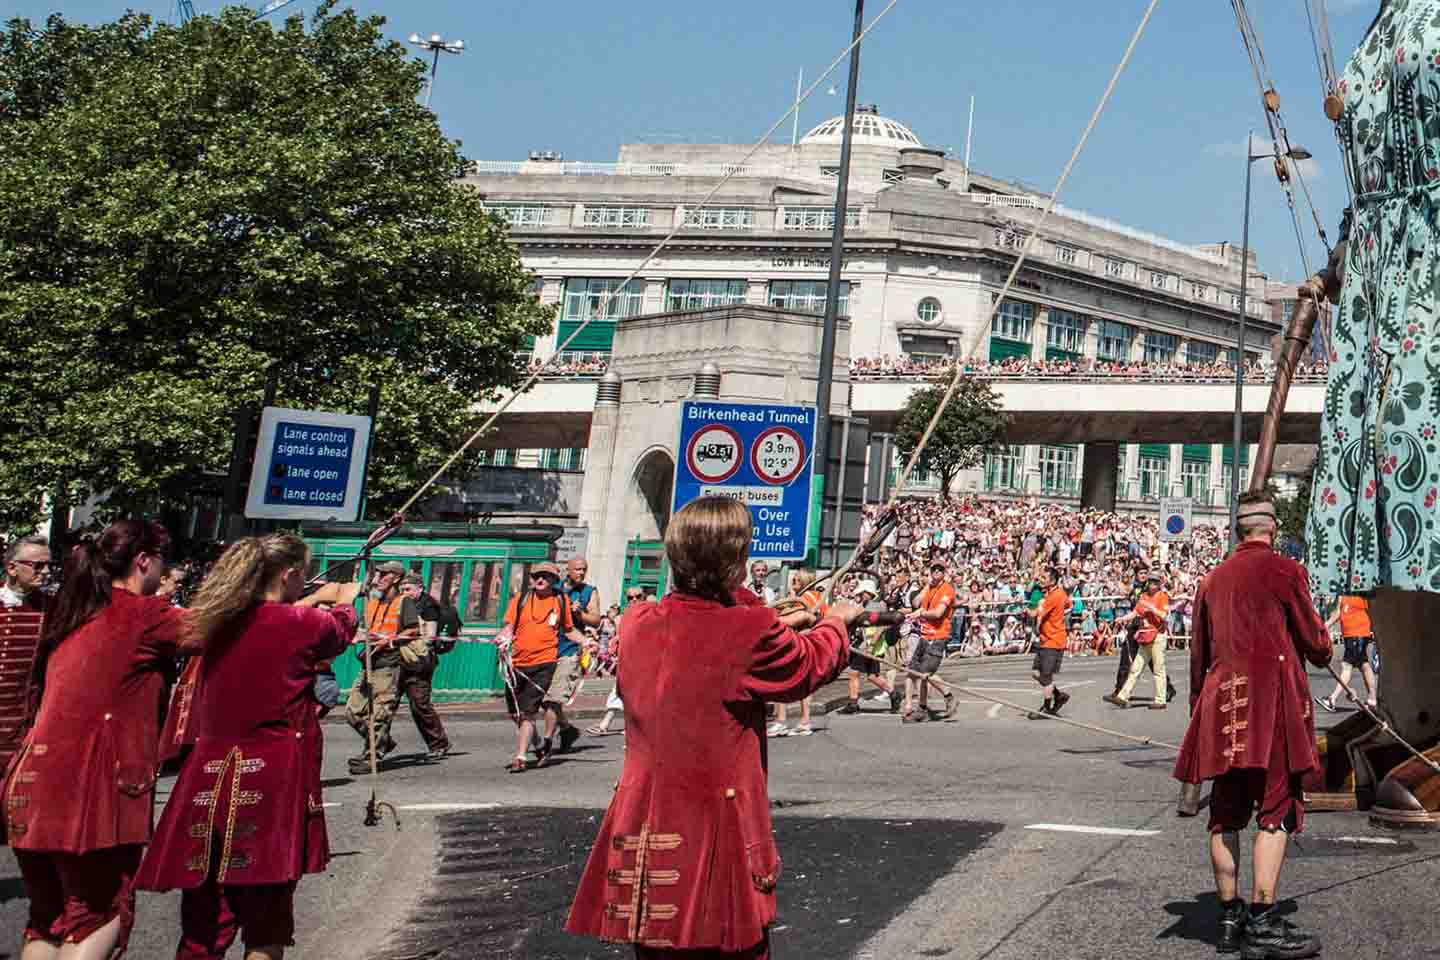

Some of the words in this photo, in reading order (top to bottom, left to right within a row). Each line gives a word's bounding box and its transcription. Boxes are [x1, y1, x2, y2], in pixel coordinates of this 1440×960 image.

[688, 406, 764, 422] Birkenhead
[768, 410, 809, 424] Tunnel
[284, 426, 308, 440] Lane
[311, 431, 347, 443] control
[277, 442, 314, 456] signals
[318, 445, 348, 457] ahead
[288, 465, 310, 478] lane
[313, 470, 338, 480] open
[283, 488, 307, 500] lane
[309, 489, 344, 502] closed
[748, 491, 779, 501] buses
[758, 508, 789, 521] Over
[766, 523, 791, 536] Use
[752, 539, 794, 552] Tunnel
